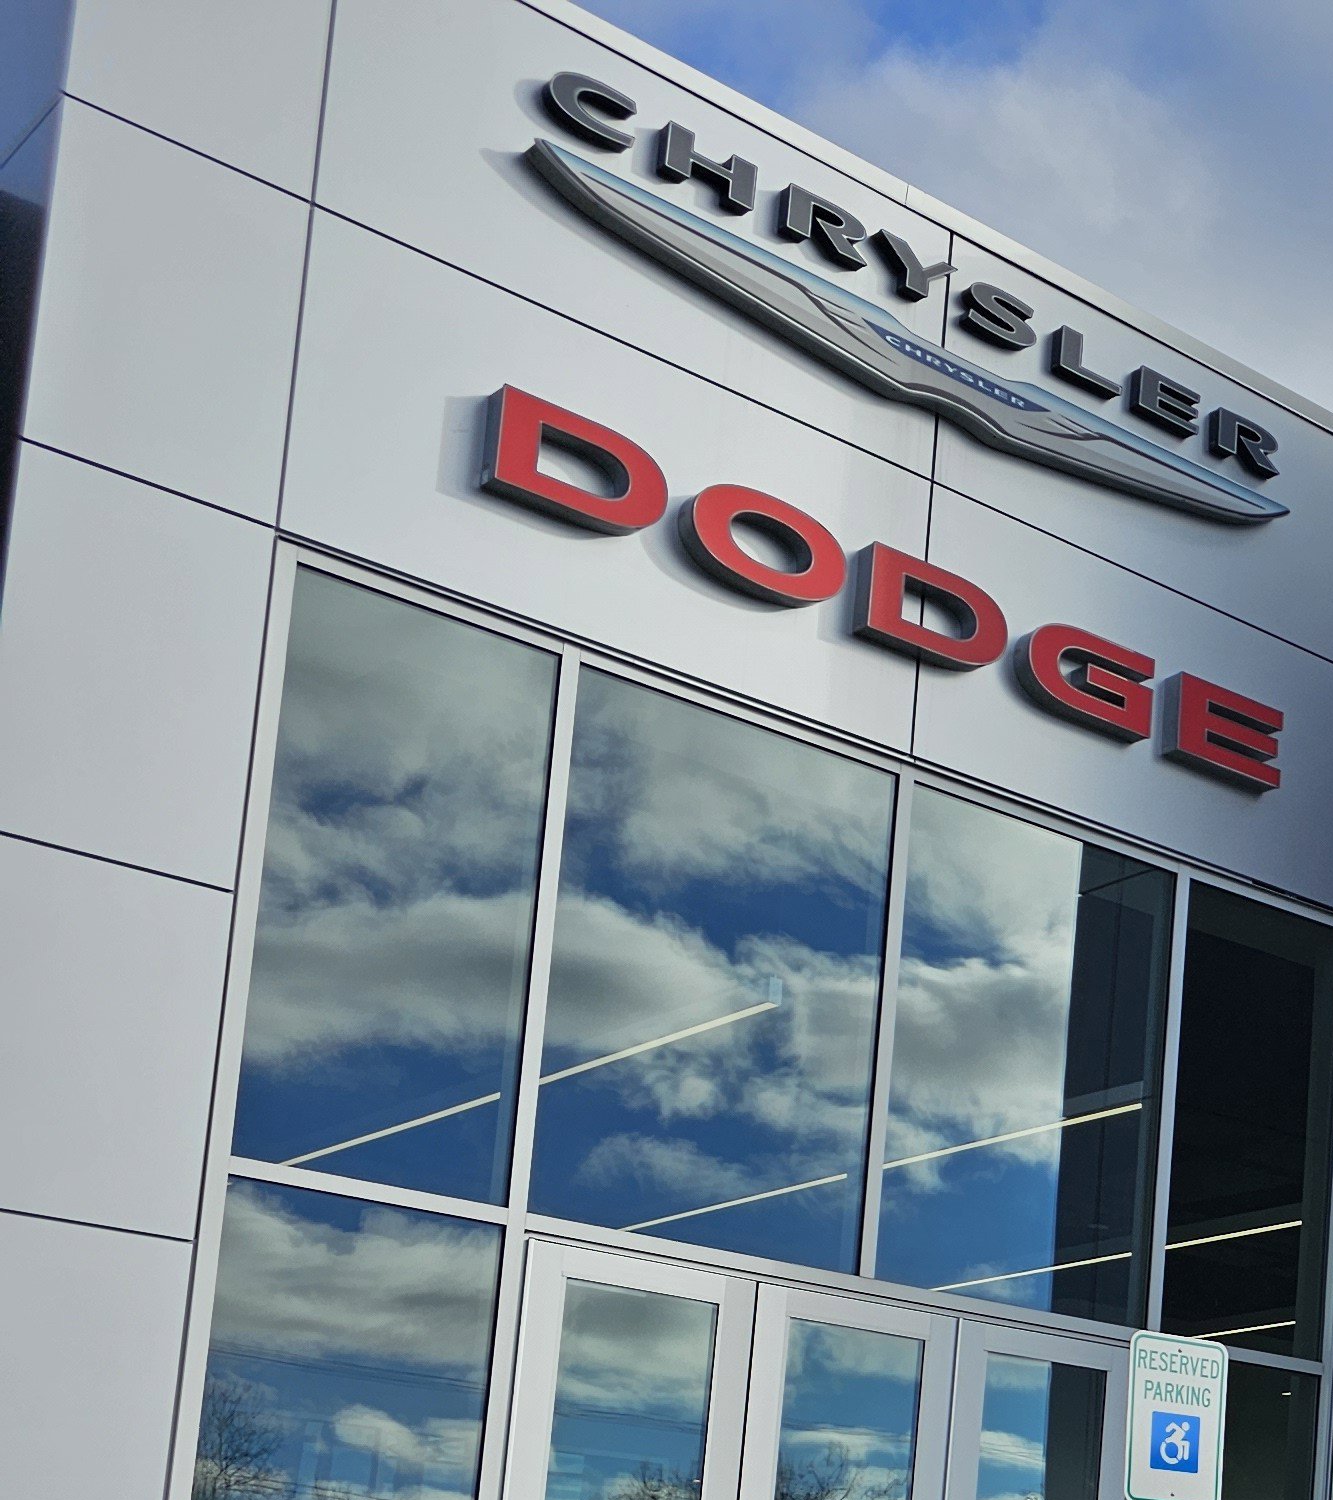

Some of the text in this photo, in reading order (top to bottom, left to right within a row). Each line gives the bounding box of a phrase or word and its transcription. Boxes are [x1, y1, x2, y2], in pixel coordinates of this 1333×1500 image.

[541, 70, 1281, 479] CHRYSLER
[885, 335, 1025, 408] CHRYSLER
[480, 383, 1285, 794] DODGE
[1137, 1348, 1220, 1379] RESERVED
[1144, 1379, 1211, 1408] PARKING
